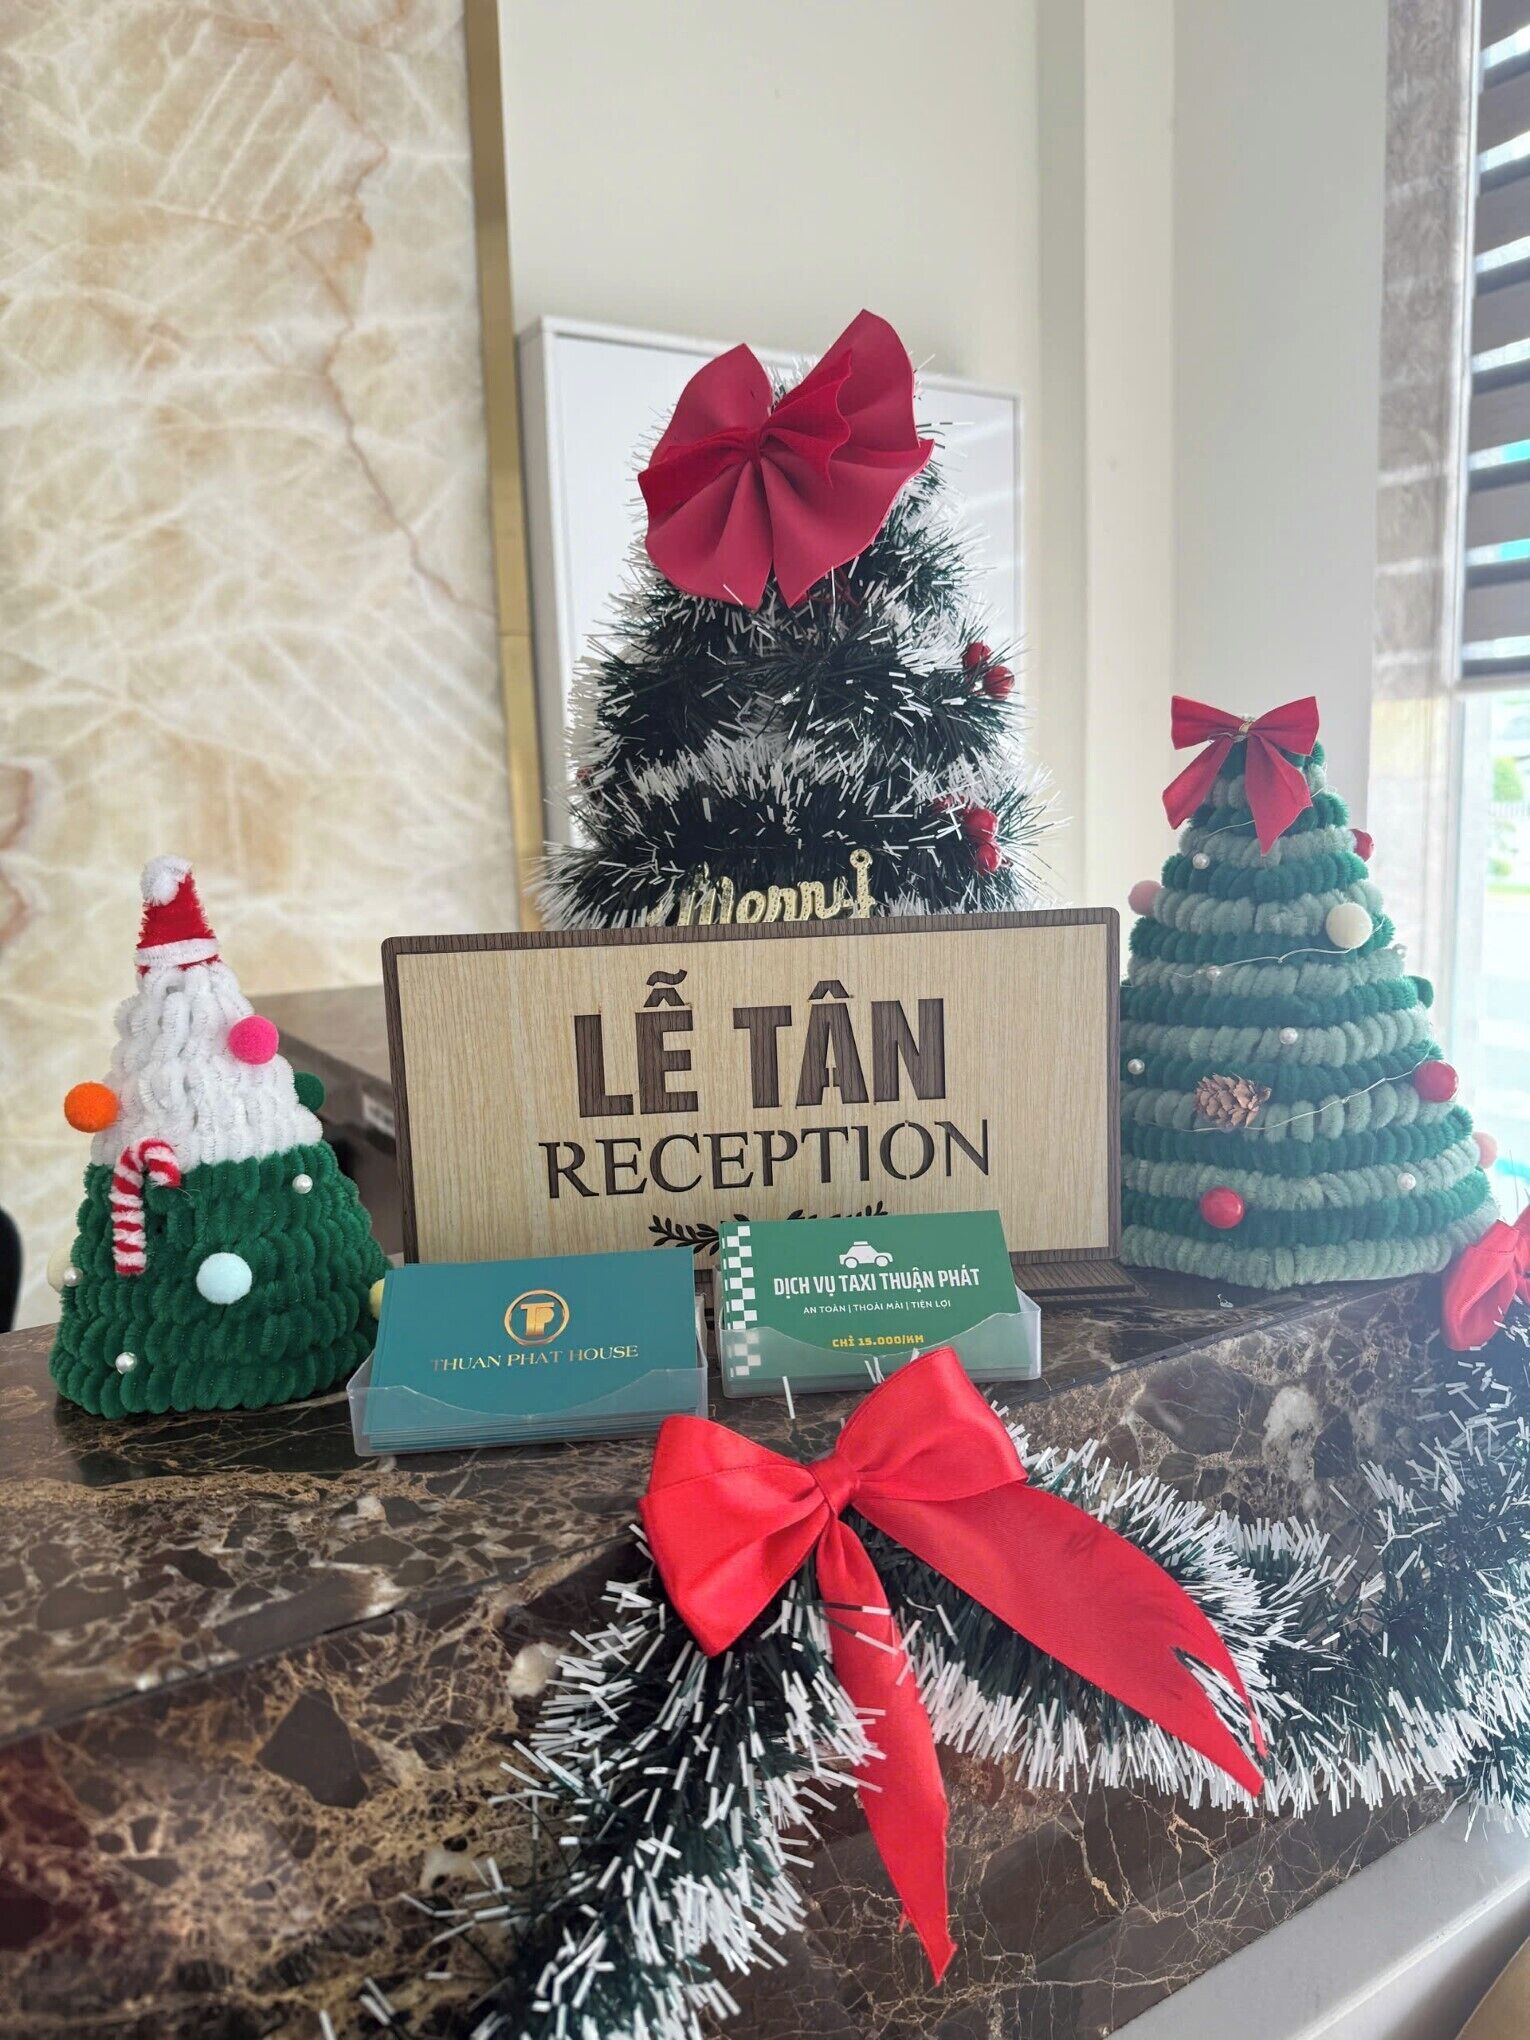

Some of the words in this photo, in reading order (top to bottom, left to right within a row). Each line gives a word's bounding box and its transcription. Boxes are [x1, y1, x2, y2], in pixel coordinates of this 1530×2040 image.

[574, 969, 699, 1118] LỄ
[733, 979, 946, 1109] TÂN
[538, 1119, 989, 1199] RECEPTION
[773, 1276, 809, 1299] DỊCH
[813, 1275, 836, 1297] VỤ
[838, 1273, 877, 1293] TAXI
[879, 1267, 935, 1293] THUẬN
[938, 1264, 980, 1288] PHÁT
[803, 1306, 817, 1314] AN
[819, 1303, 846, 1313] TOÀN
[911, 1299, 933, 1309] TIỆN
[935, 1299, 951, 1309] LỢI
[831, 1335, 855, 1347] CHỈ
[858, 1334, 924, 1346] 15.000/KM
[431, 1354, 501, 1372] THUAN
[506, 1350, 563, 1367] PHAT
[568, 1345, 639, 1362] HOUSE
